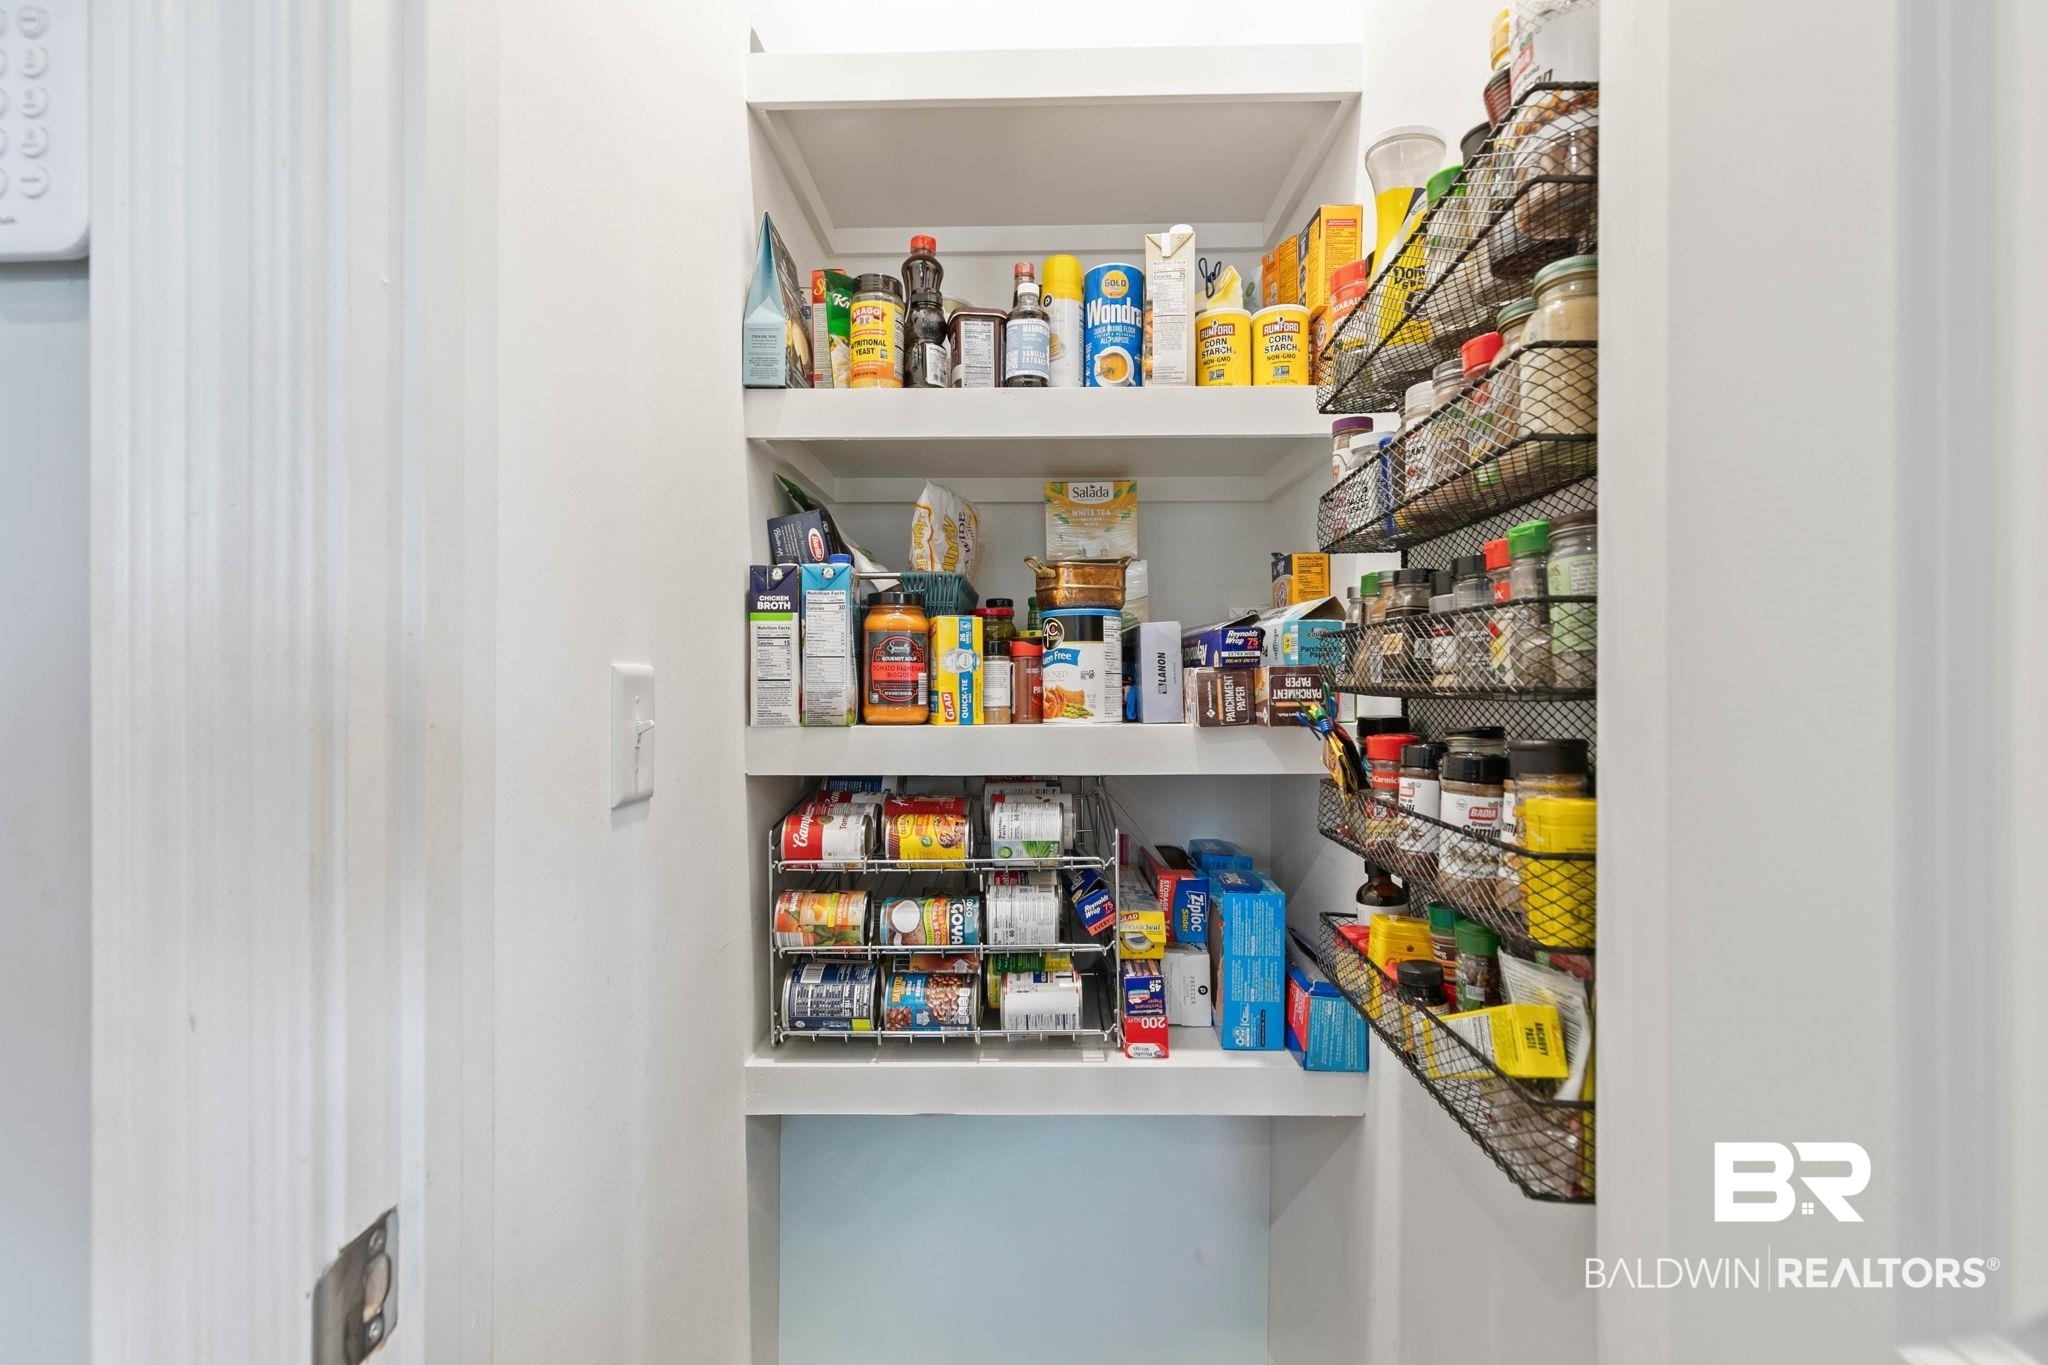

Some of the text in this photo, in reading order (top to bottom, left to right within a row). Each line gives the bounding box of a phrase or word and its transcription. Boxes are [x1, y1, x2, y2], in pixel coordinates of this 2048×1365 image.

[1104, 278, 1127, 287] GOLD
[853, 307, 881, 320] BRAGG
[1087, 296, 1142, 329] Wondra
[1200, 324, 1234, 340] RUMFORD
[1263, 322, 1299, 336] RUMFORD
[1204, 338, 1228, 349] CORN
[1268, 335, 1293, 344] CORN
[855, 347, 876, 357] YEAST
[1201, 346, 1232, 359] STARCH
[1264, 343, 1297, 354] STARCH
[1203, 356, 1231, 366] NON-GMO
[1266, 353, 1296, 361] NON-GMO
[1072, 485, 1109, 498] Salada
[757, 601, 791, 610] BROTH
[1228, 630, 1258, 638] Reynolds
[1225, 637, 1244, 645] Wrap
[1247, 638, 1258, 646] 75
[1054, 651, 1072, 660] Free
[1285, 676, 1312, 687] PAPER
[1223, 674, 1236, 722] PARCHMENT
[1236, 686, 1247, 711] PAPER
[1272, 688, 1322, 700] PARCHMENT
[943, 693, 955, 720] GLAD
[1470, 808, 1497, 819] BADIA
[1084, 894, 1109, 913] Reynolds
[1103, 902, 1114, 911] 75
[1085, 907, 1101, 919] Wrap
[1187, 894, 1204, 932] Ziploc
[951, 902, 963, 946] GOYA
[1182, 908, 1190, 933] Slider
[1149, 984, 1161, 992] 45
[1141, 1016, 1166, 1029] 200
[1524, 1027, 1537, 1051] PASTE
[1534, 1022, 1548, 1057] ANCHOVY
